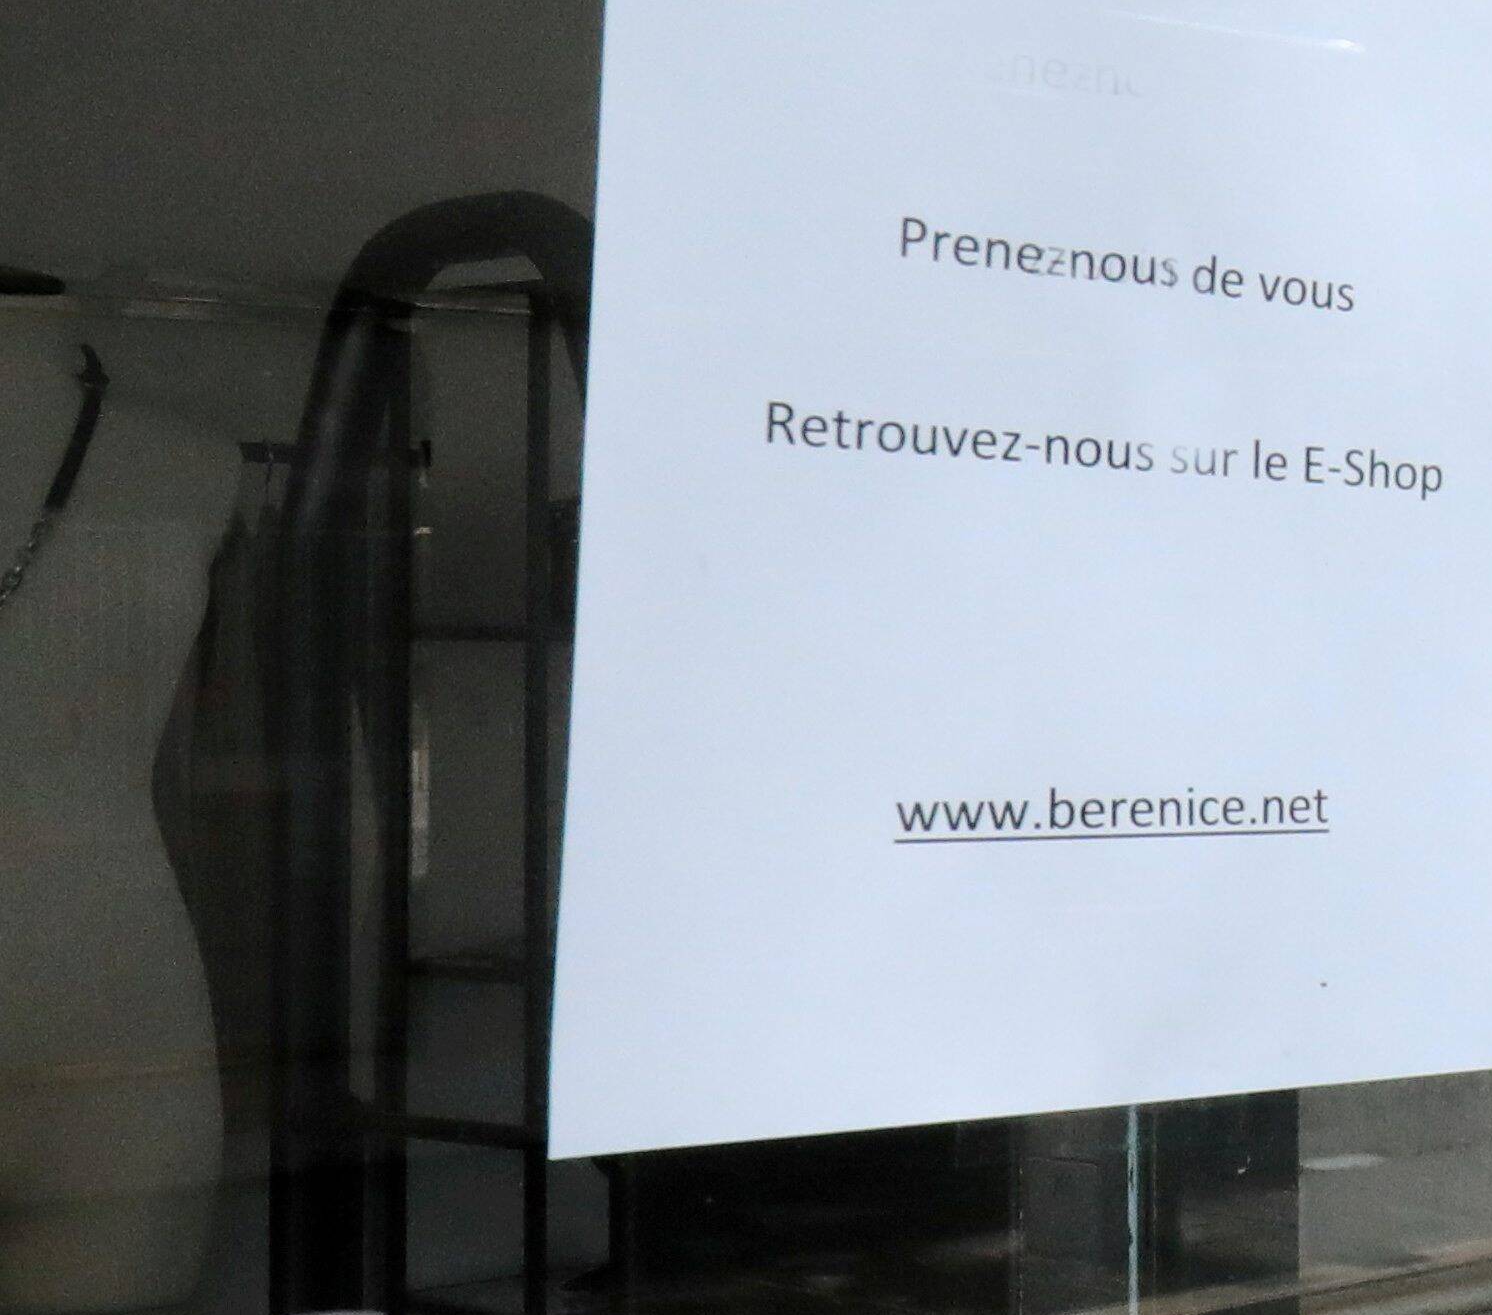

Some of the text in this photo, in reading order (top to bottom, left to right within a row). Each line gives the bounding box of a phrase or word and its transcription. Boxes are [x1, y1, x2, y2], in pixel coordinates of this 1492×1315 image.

[1192, 254, 1245, 299] de
[1257, 272, 1356, 313] vous
[766, 401, 1444, 502] Retrouvez-nous sur le E-Shop
[895, 787, 1330, 835] www.berenice.net
